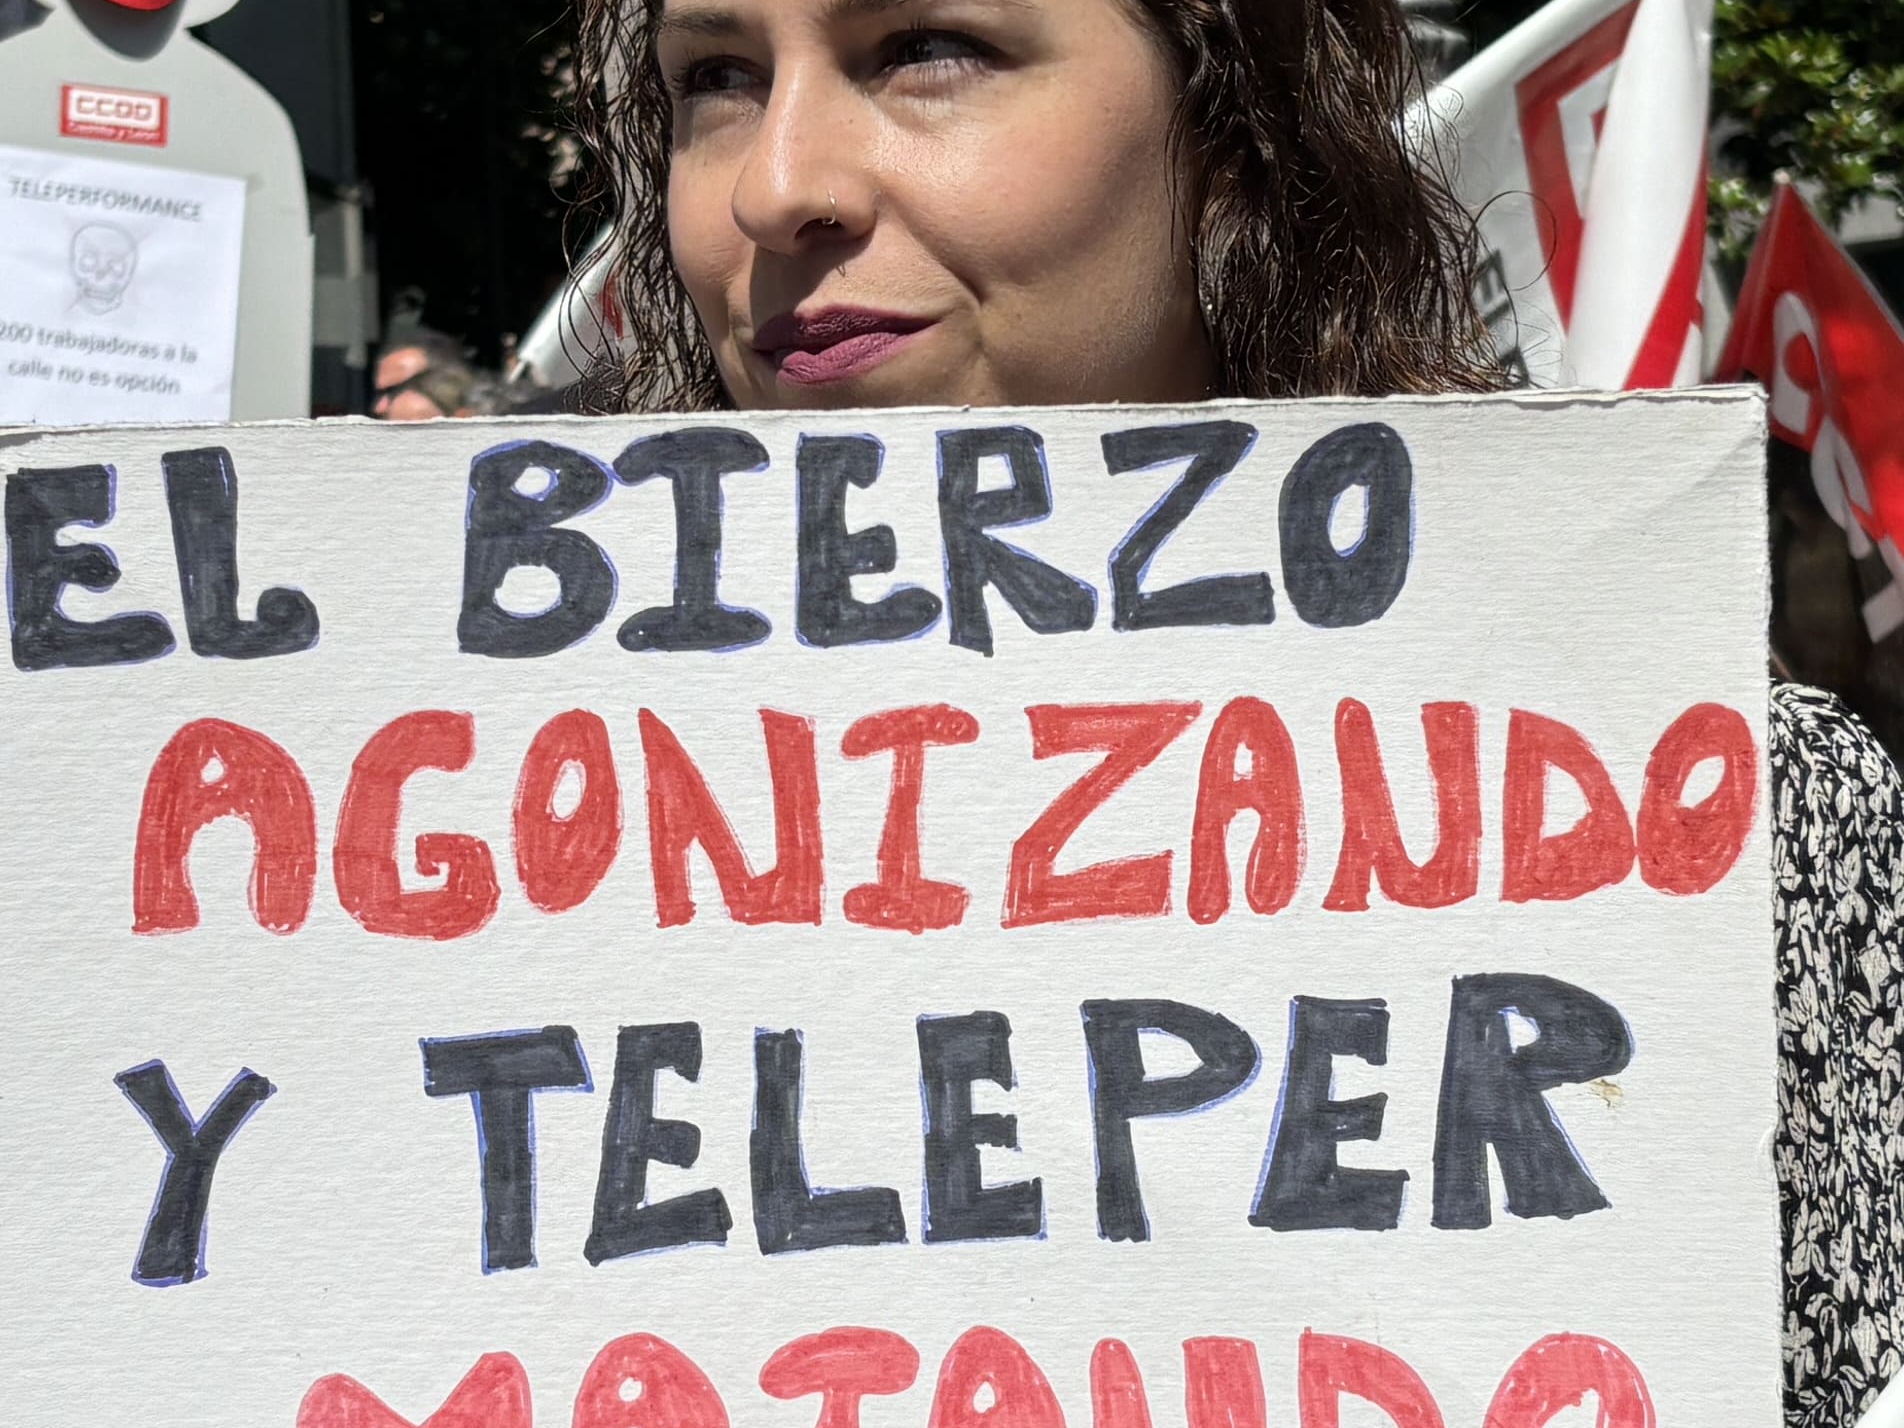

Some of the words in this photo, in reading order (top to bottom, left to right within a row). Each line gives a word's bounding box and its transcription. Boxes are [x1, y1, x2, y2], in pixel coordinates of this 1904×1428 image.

[77, 96, 152, 120] CCOO
[8, 175, 203, 222] TELEPERFORMANCE
[37, 326, 160, 361] trabajadoras
[162, 345, 177, 361] a
[180, 341, 199, 365] la
[8, 358, 54, 382] calle
[57, 365, 84, 384] no
[89, 369, 111, 386] es
[115, 371, 181, 397] opción
[4, 446, 320, 672] EL
[457, 419, 1417, 659] BIERZO
[132, 694, 1759, 941] AGONIZANDO
[113, 1058, 278, 1288] Y
[418, 972, 1636, 1276] TELEPER
